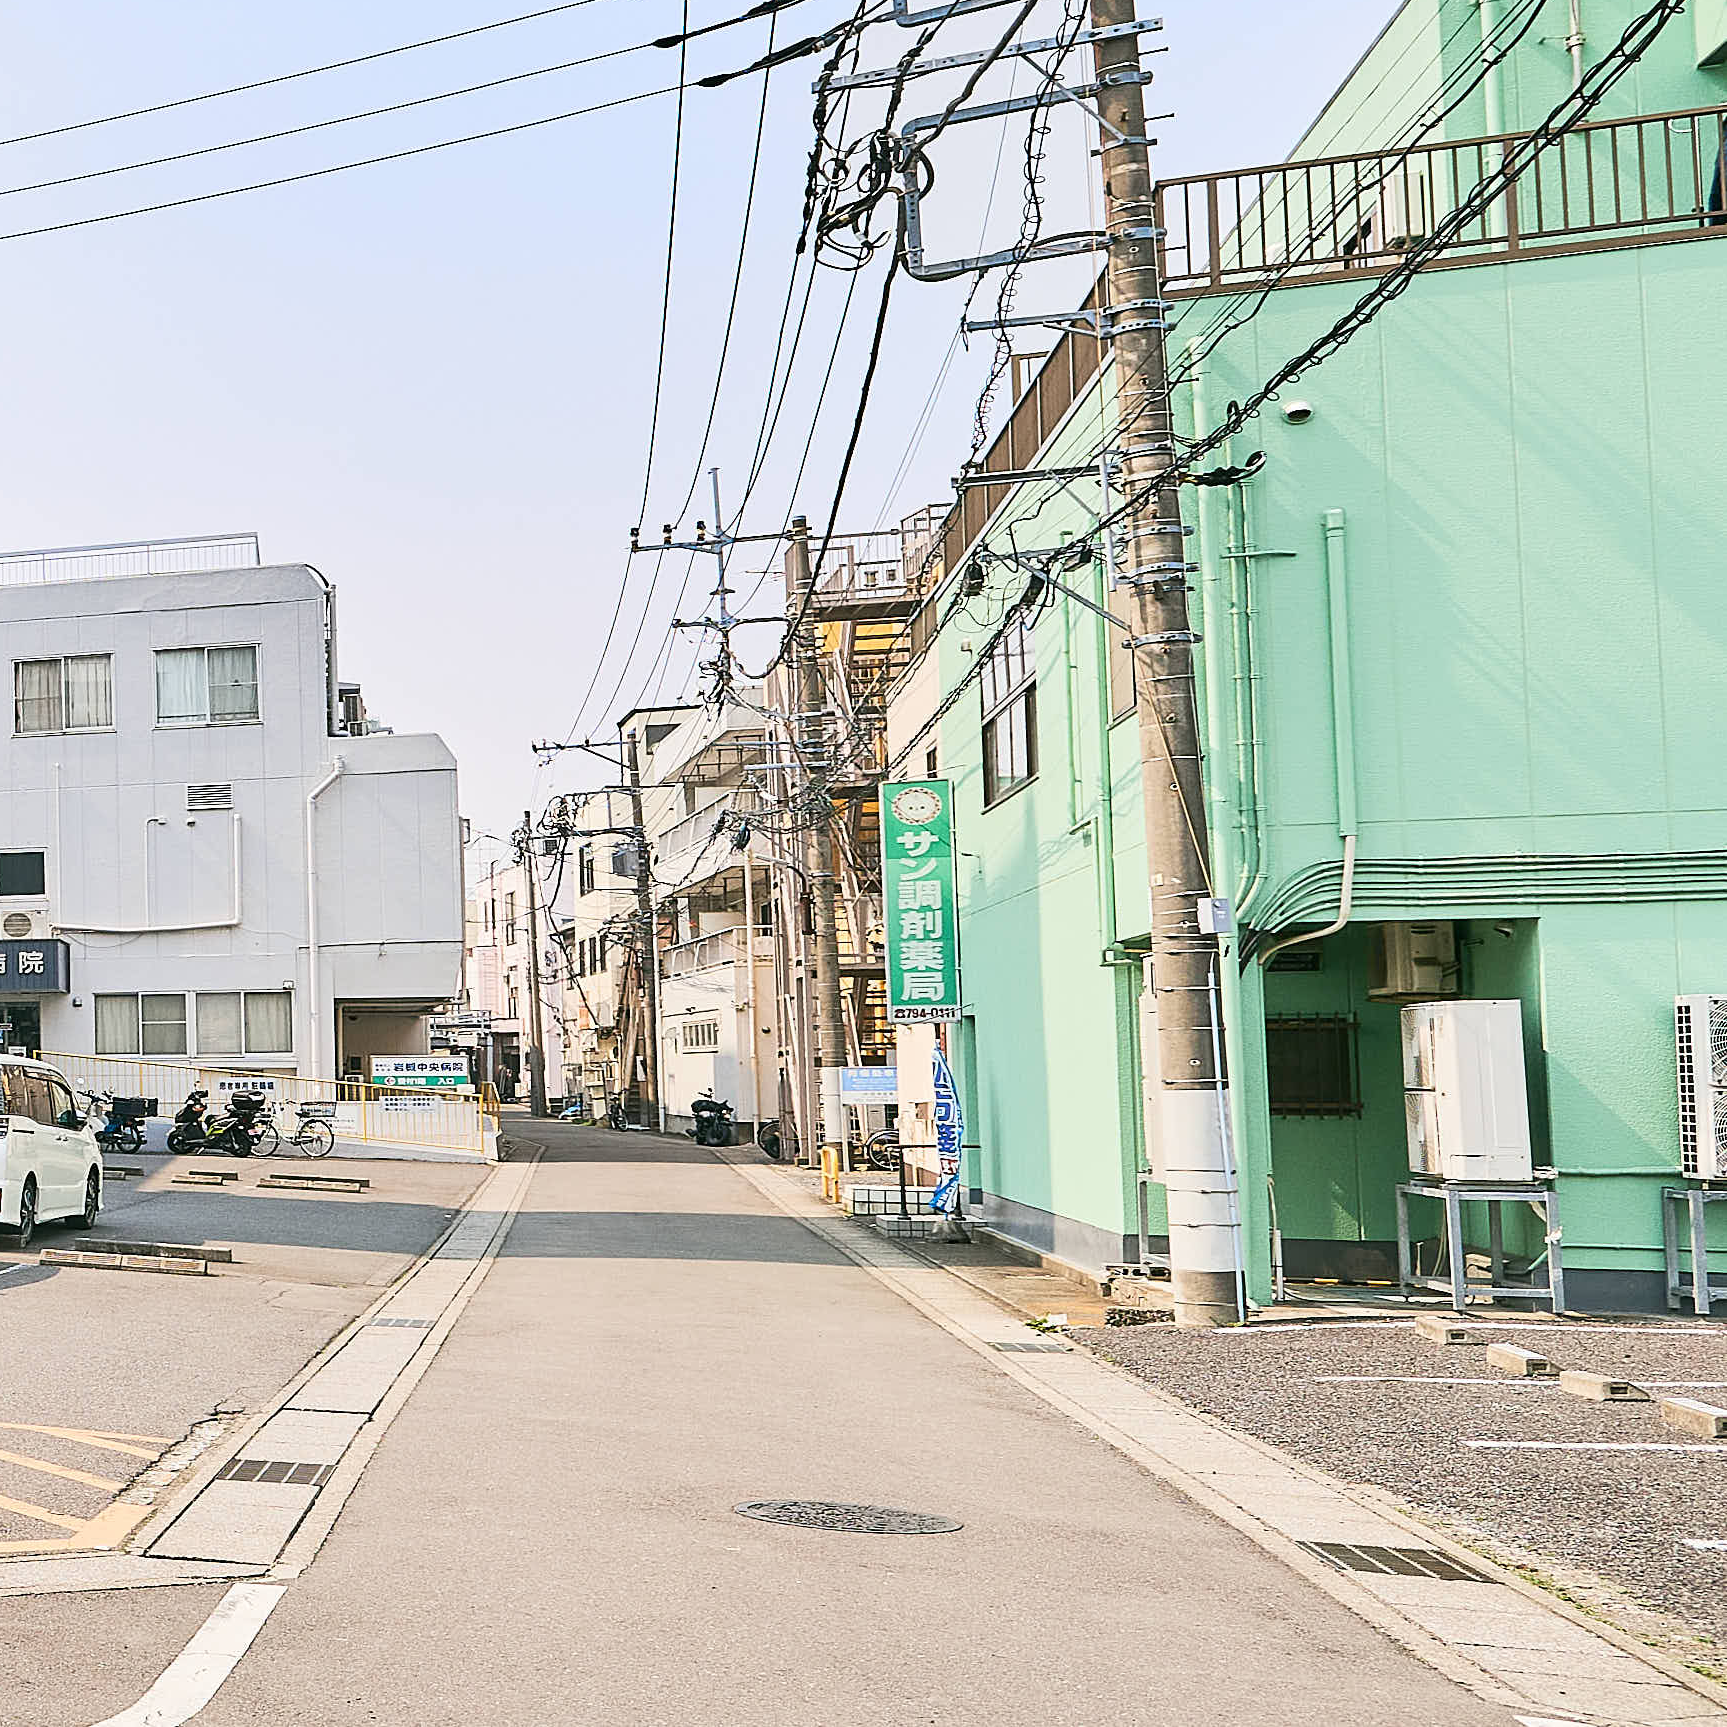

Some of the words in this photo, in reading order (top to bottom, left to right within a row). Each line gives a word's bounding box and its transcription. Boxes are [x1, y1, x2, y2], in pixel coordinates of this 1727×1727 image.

[896, 830, 946, 1002] サン調剤薬局
